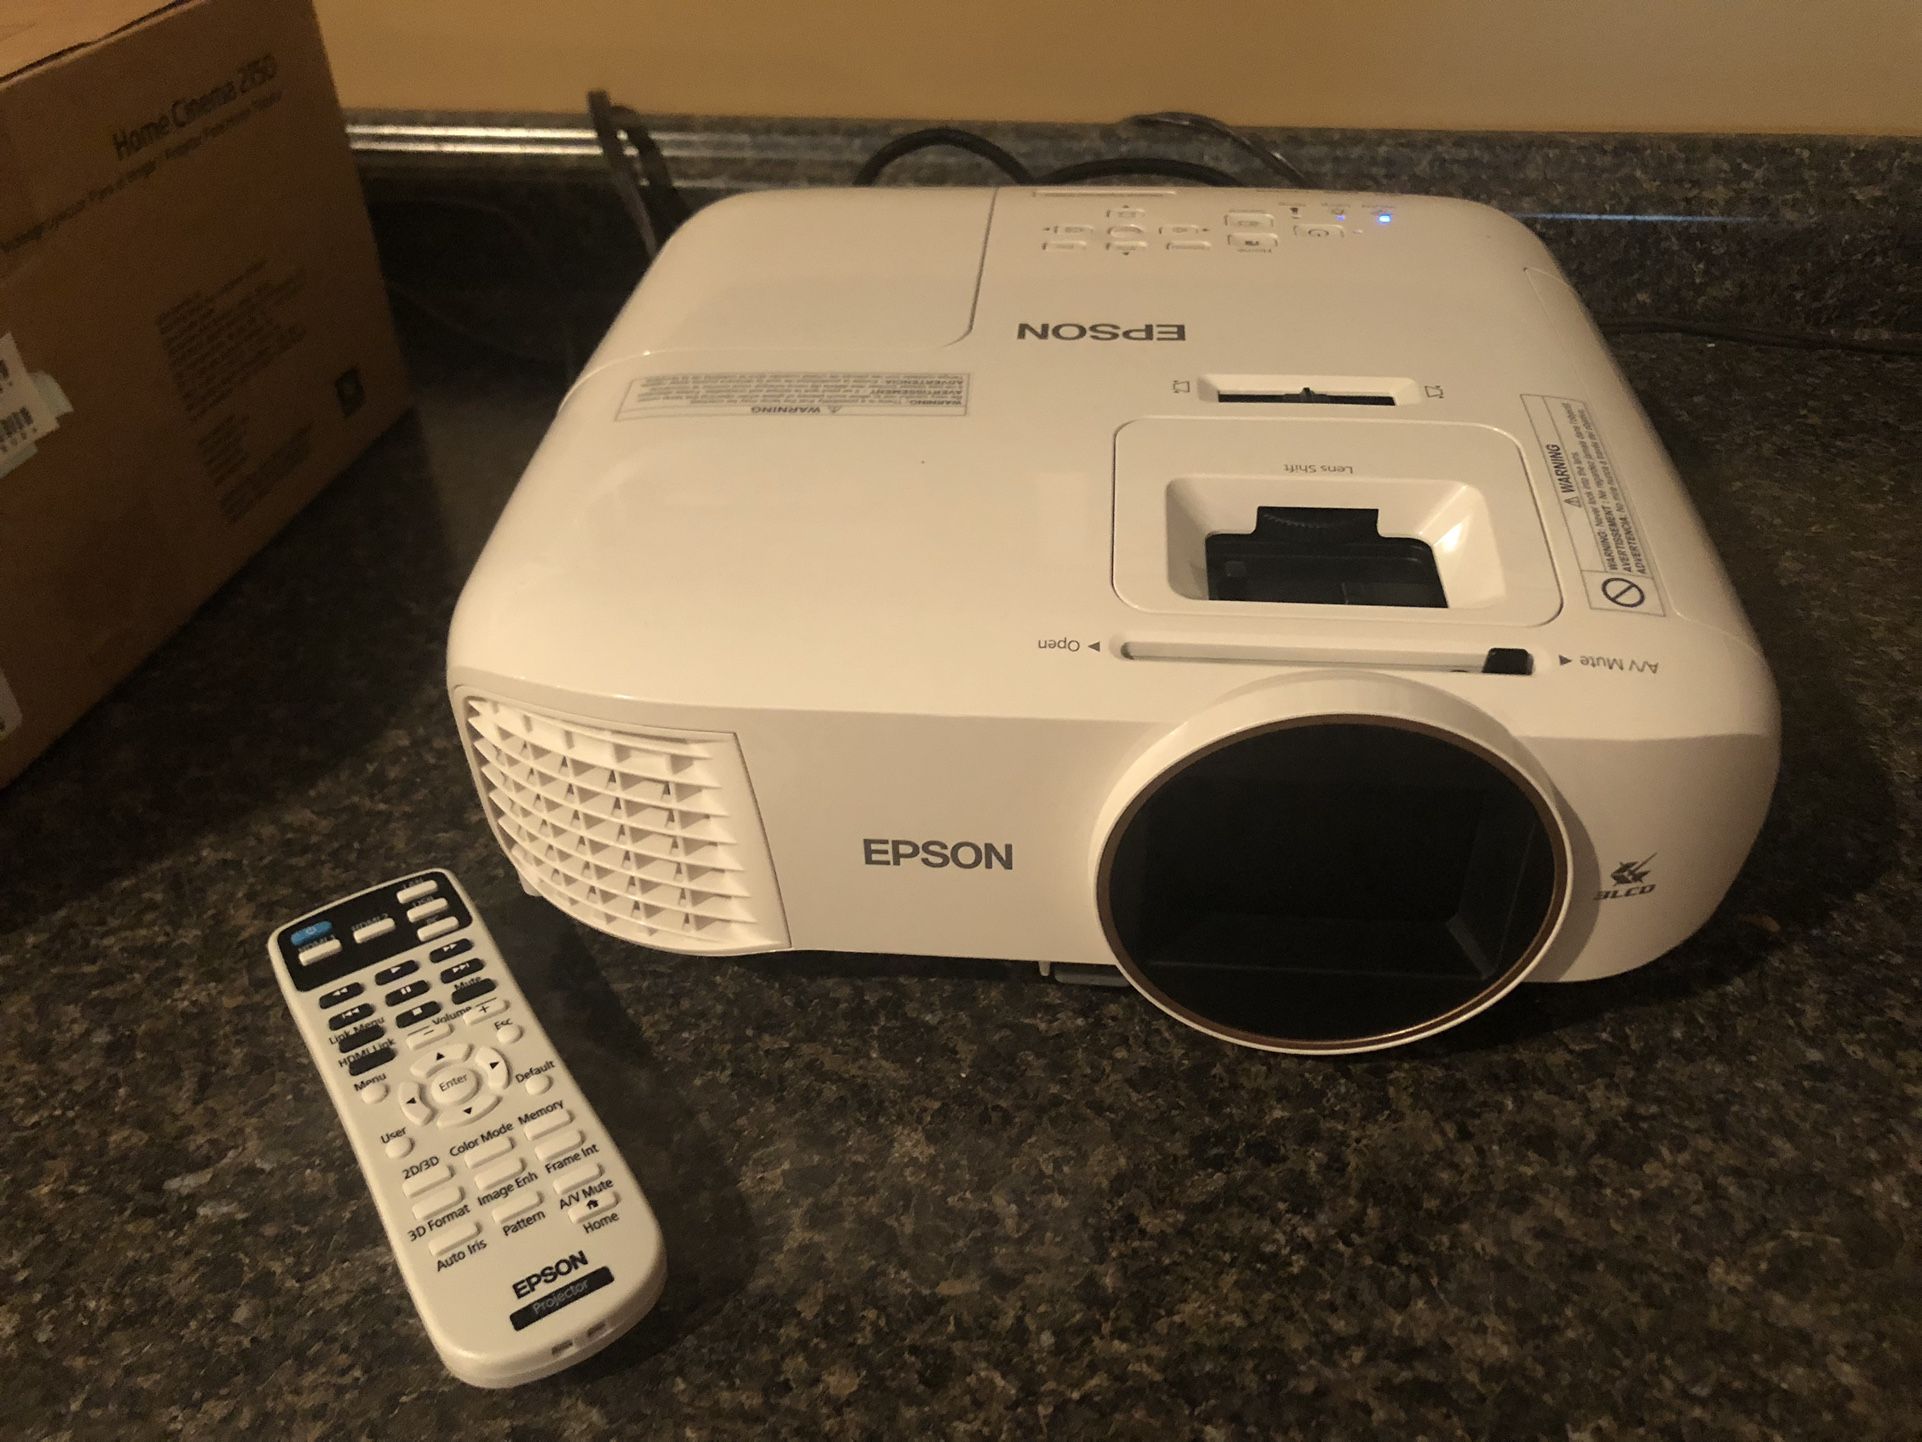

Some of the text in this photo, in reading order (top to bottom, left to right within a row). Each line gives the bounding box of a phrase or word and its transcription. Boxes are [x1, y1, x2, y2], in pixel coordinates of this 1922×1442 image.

[1017, 323, 1186, 341] EPSON
[751, 406, 821, 414] WARNING
[1283, 464, 1353, 474] Lens Shift
[1546, 444, 1576, 493] WARNING
[1601, 505, 1632, 572] AVERTISSEMENT
[1038, 636, 1081, 652] Open
[1579, 655, 1659, 674] A/V Mute
[863, 838, 1013, 870] EPSON
[432, 1004, 472, 1025] Volume
[494, 1017, 513, 1031] Esc
[354, 1072, 387, 1092] Menu
[439, 1072, 468, 1093] Enter
[515, 1059, 556, 1084] Default
[517, 1100, 565, 1125] Memory
[380, 1126, 408, 1145] User
[449, 1121, 514, 1158] Color Mode
[402, 1155, 440, 1180] 2D/3D
[545, 1143, 600, 1175] Frame Int
[477, 1171, 539, 1207] Image Enh
[559, 1178, 614, 1210] A/V Mute
[407, 1203, 471, 1243] 3D Format
[502, 1209, 546, 1237] Pattern
[583, 1211, 620, 1235] Home
[436, 1237, 487, 1272] Auto Iris
[512, 1250, 589, 1299] EPSON
[532, 1279, 589, 1315] Projector
